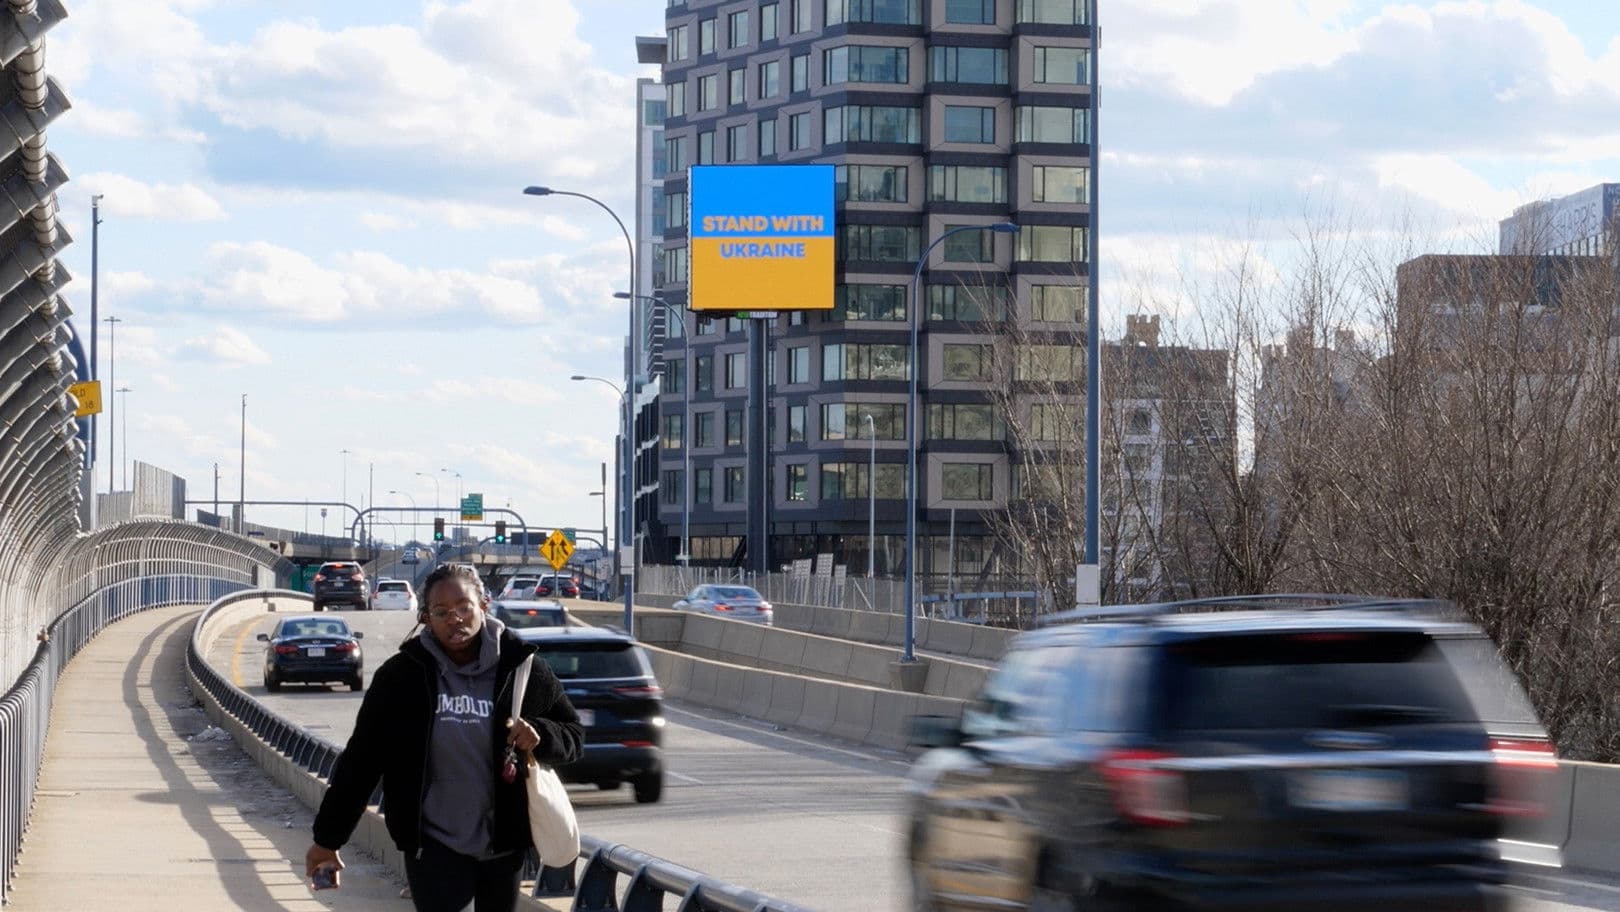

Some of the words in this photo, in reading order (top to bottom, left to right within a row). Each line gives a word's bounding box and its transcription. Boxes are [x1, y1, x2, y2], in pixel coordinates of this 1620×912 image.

[703, 216, 768, 231] STAND
[771, 216, 824, 231] WITH
[721, 243, 805, 258] UKRAINE
